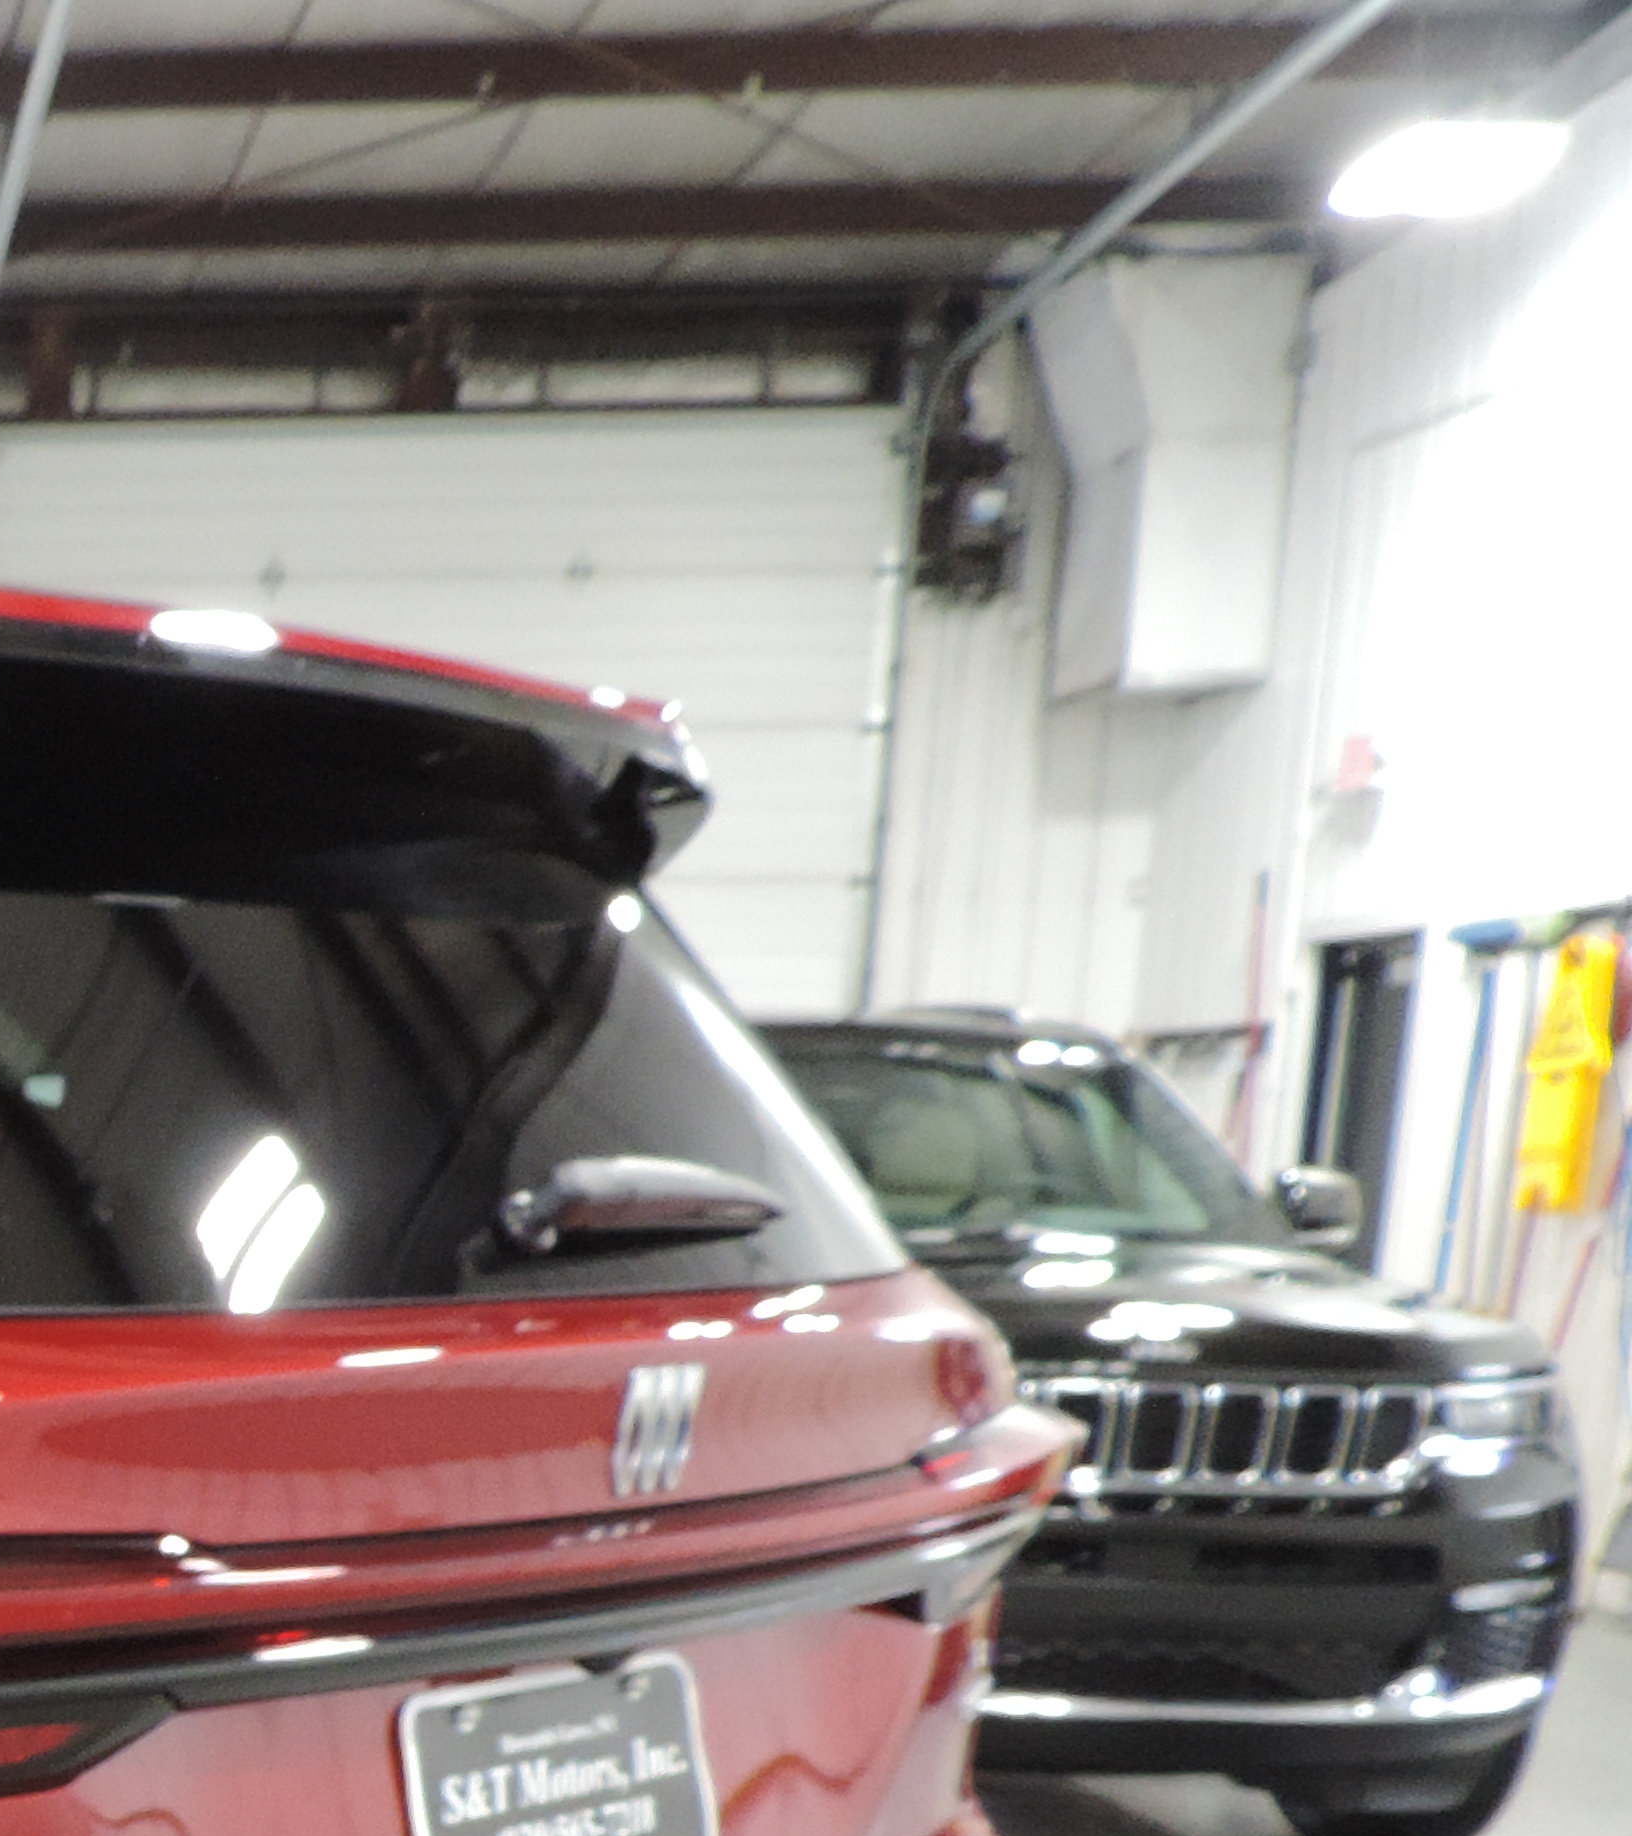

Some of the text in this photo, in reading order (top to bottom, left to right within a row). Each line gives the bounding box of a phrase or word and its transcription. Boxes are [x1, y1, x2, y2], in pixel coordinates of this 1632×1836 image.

[441, 1737, 688, 1825] S&T Motors, Inc.
